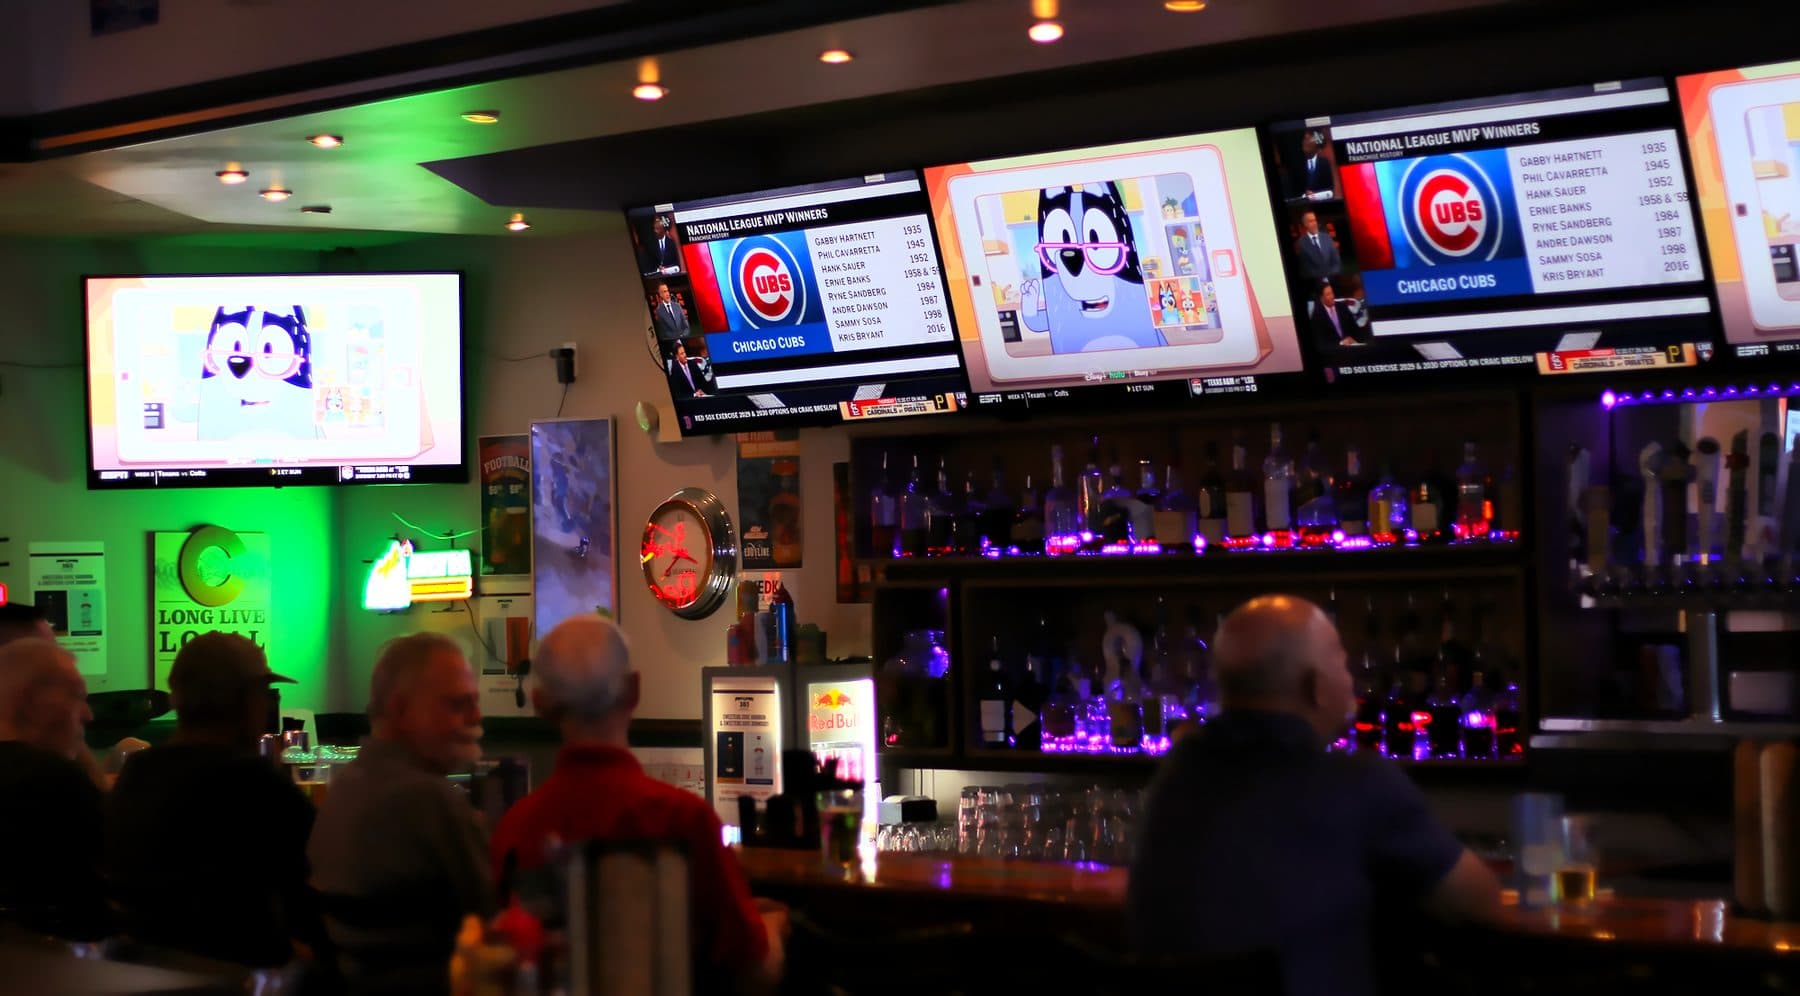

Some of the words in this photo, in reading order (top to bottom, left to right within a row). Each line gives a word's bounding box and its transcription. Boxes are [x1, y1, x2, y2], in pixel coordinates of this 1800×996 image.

[1346, 137, 1404, 155] NATIONAL
[1405, 132, 1450, 149] LEAGUE
[1452, 127, 1480, 143] MVP
[1482, 122, 1540, 139] WINNERS
[1642, 142, 1667, 154] 1935
[1379, 151, 1404, 159] HISTORY
[1520, 155, 1551, 167] GABBY
[1554, 150, 1602, 163] HARTNETT
[1645, 159, 1670, 171] 1945
[1523, 173, 1544, 183] PHIL
[1546, 166, 1608, 181] CAVARRETTA
[1648, 176, 1673, 188] 1952
[1526, 190, 1553, 200] HANK
[1555, 186, 1586, 197] SAUER
[1664, 193, 1672, 203] &
[1529, 206, 1558, 216] ERNIE
[1560, 202, 1592, 214] BANKS
[686, 222, 729, 236] NATIONAL
[729, 217, 762, 230] LEAGUE
[764, 213, 784, 226] MVP
[785, 208, 829, 223] WINNERS
[1655, 210, 1679, 222] 1984
[903, 224, 922, 235] 1935
[1532, 222, 1558, 233] RYNE
[1560, 217, 1612, 230] SANDBERG
[814, 235, 838, 246] GABBY
[839, 231, 875, 243] HARTNETT
[1658, 227, 1682, 239] 1987
[906, 239, 925, 249] 1945
[1536, 238, 1568, 249] ANDRE
[1570, 233, 1613, 246] DAWSON
[818, 251, 834, 260] PHIL
[835, 245, 880, 258] CAVARRETTA
[1662, 244, 1686, 255] 1998
[910, 253, 929, 264] 1952
[1539, 255, 1574, 266] SAMMY
[1576, 252, 1602, 262] SOSA
[821, 265, 841, 273] HANK
[843, 261, 865, 271] SAUER
[923, 267, 929, 277] &
[1664, 261, 1689, 272] 2016
[1542, 271, 1565, 281] KRIS
[1567, 268, 1604, 280] BRYANT
[825, 278, 845, 287] ERNIE
[846, 275, 871, 286] BANKS
[916, 281, 935, 292] 1984
[1397, 277, 1457, 294] CHICAGO
[1459, 274, 1497, 289] CUBS
[828, 291, 849, 301] RYNE
[849, 287, 887, 299] SANDBERG
[920, 295, 938, 306] 1987
[832, 305, 855, 315] ANDRE
[857, 302, 888, 313] DAWSON
[923, 309, 942, 320] 1998
[835, 319, 861, 328] SAMMY
[862, 316, 881, 326] SOSA
[926, 323, 946, 334] 2016
[839, 333, 855, 342] KRIS
[856, 330, 884, 341] BRYANT
[732, 338, 777, 353] CHICAGO
[777, 335, 806, 349] CUBS
[1737, 345, 1769, 356] ESPN
[1339, 367, 1353, 375] RED
[1354, 366, 1367, 374] SOX
[1368, 363, 1399, 373] EXERCISE
[1416, 362, 1422, 370] &
[1439, 360, 1468, 369] OPTIONS
[1480, 357, 1500, 366] CRAIG
[1501, 355, 1534, 365] BRESLOW
[935, 395, 944, 409] P
[979, 394, 1002, 403] ESPN
[716, 411, 738, 420] EXERCISE
[769, 408, 790, 416] OPTIONS
[798, 405, 814, 414] CRAIG
[484, 455, 530, 475] FOOTBALL
[158, 609, 214, 625] LONG
[219, 609, 265, 624] LIVE
